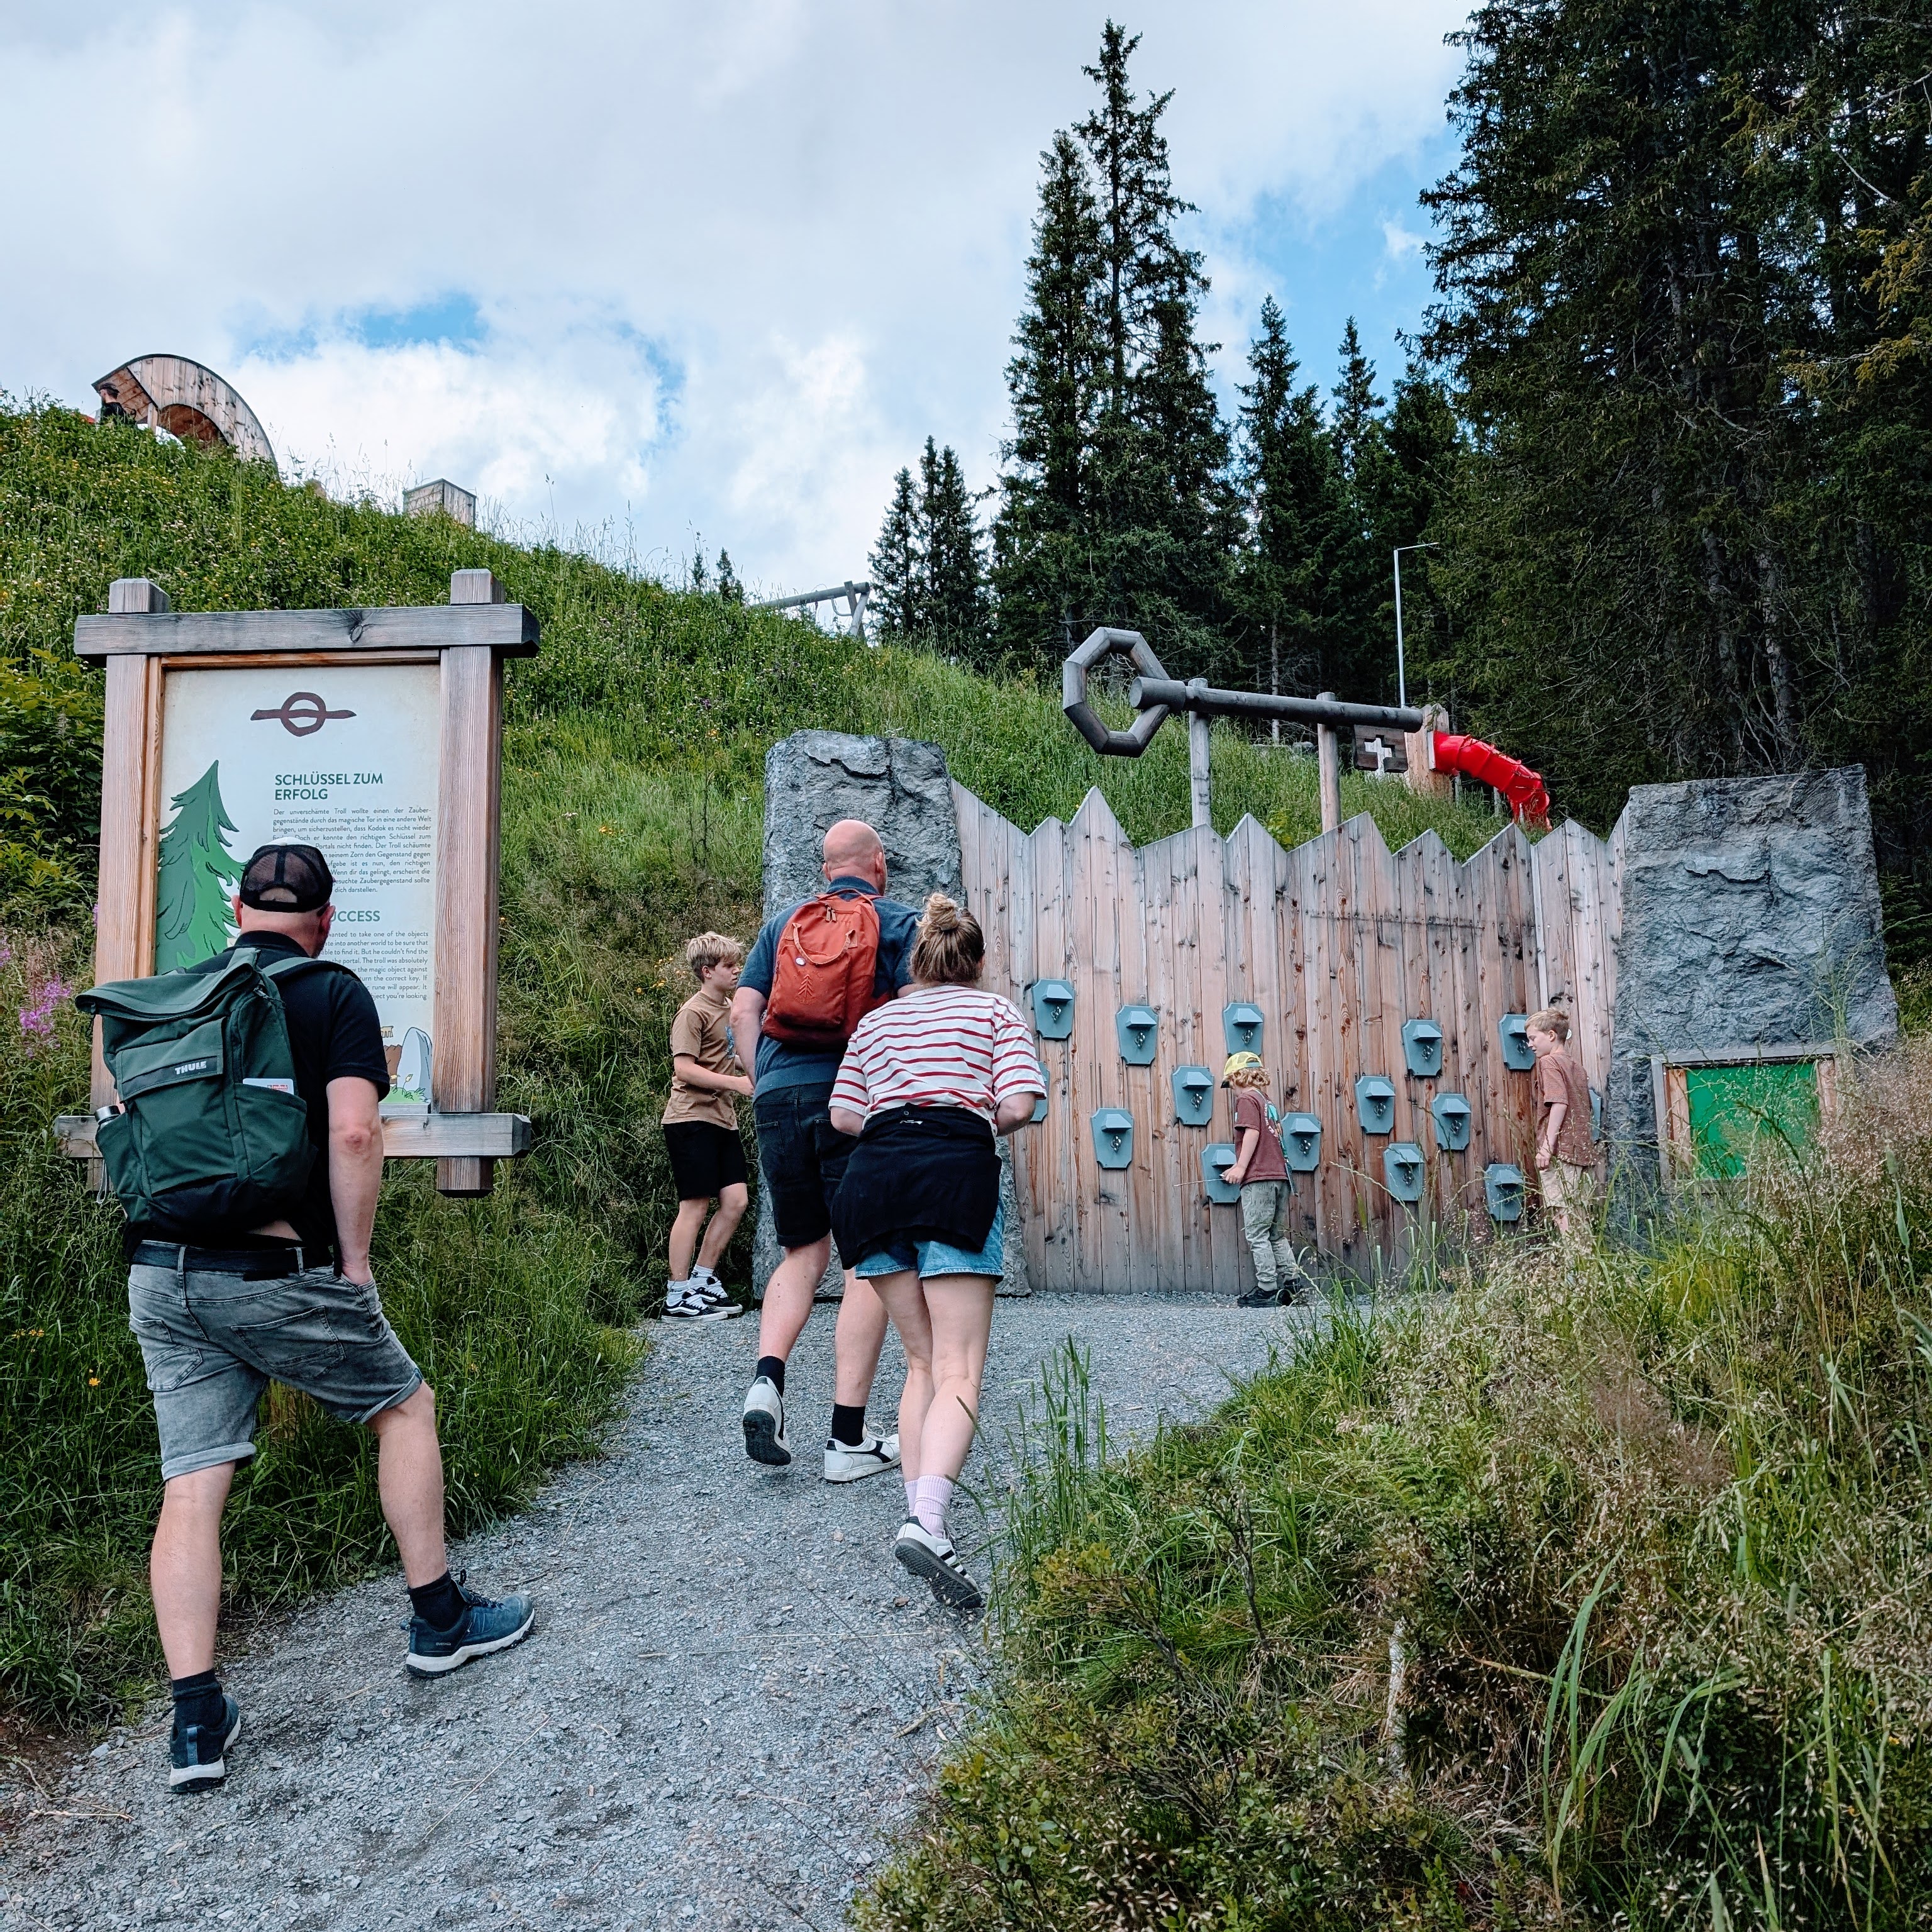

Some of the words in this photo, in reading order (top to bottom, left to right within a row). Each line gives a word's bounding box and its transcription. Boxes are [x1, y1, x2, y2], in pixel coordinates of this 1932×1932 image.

[275, 771, 350, 786] SCHLÜSSEL
[353, 773, 383, 784] ZUM
[275, 788, 328, 800] ERFOLG
[377, 850, 411, 859] Gegenstand
[327, 861, 346, 869] ufgabe
[370, 869, 391, 877] gelingt,
[360, 877, 412, 886] Zaubergegenstand
[331, 911, 380, 922] UCCESS
[408, 930, 428, 938] objects
[399, 956, 428, 965] absolutely
[369, 966, 386, 974] magic
[387, 966, 406, 974] object
[408, 966, 428, 974] against
[372, 992, 385, 1001] ject
[406, 992, 427, 1001] looking
[175, 1061, 206, 1075] THULE
